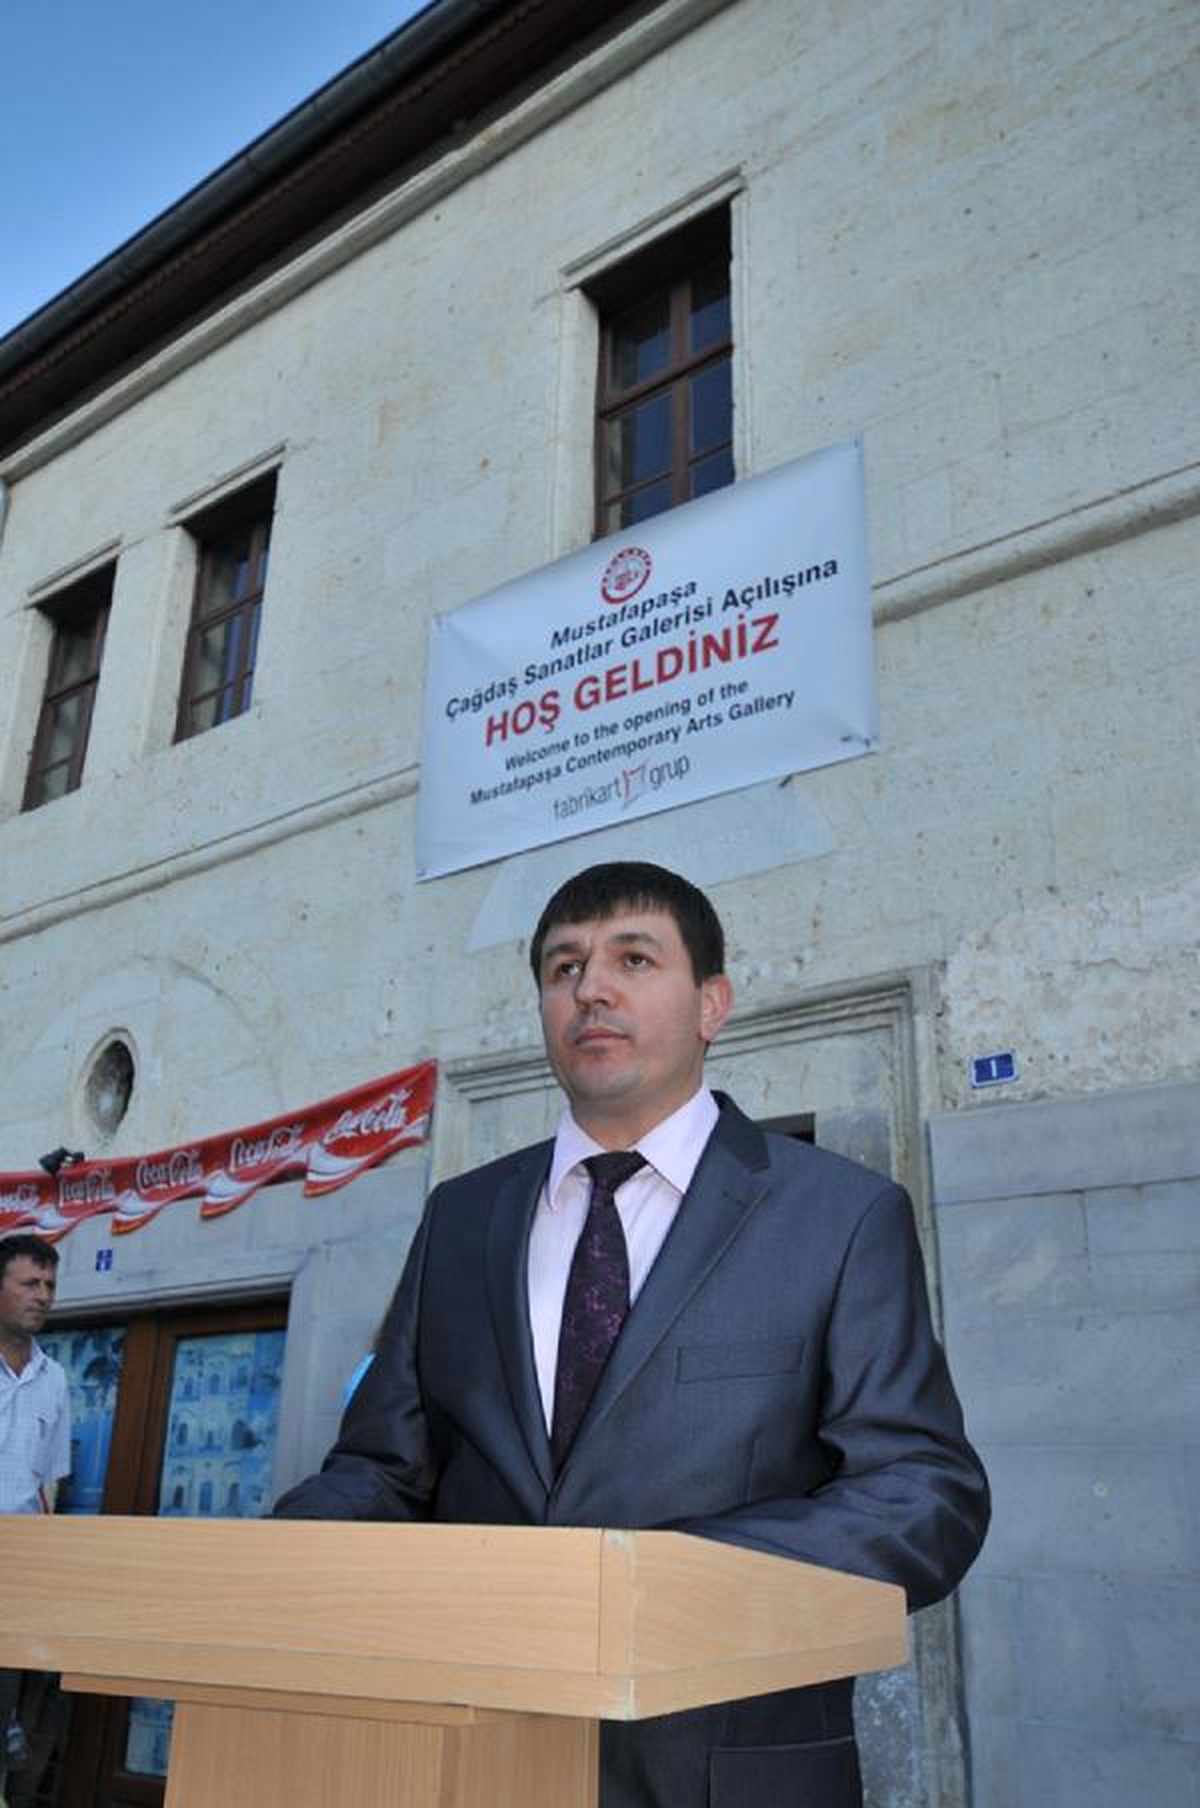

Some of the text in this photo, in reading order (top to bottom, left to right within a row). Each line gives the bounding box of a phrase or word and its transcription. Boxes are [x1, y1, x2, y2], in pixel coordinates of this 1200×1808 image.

[445, 558, 838, 719] Çağdaş Sanatlar Galerisi Açılışına
[551, 581, 697, 649] Mustafapaşa
[485, 613, 780, 748] HOŞ GELDİNİZ
[504, 680, 749, 771] Welcome to the opening of the
[469, 689, 796, 804] Mustafapaşa Contemporary Arts Gallery
[553, 754, 691, 821] fabrikart grup
